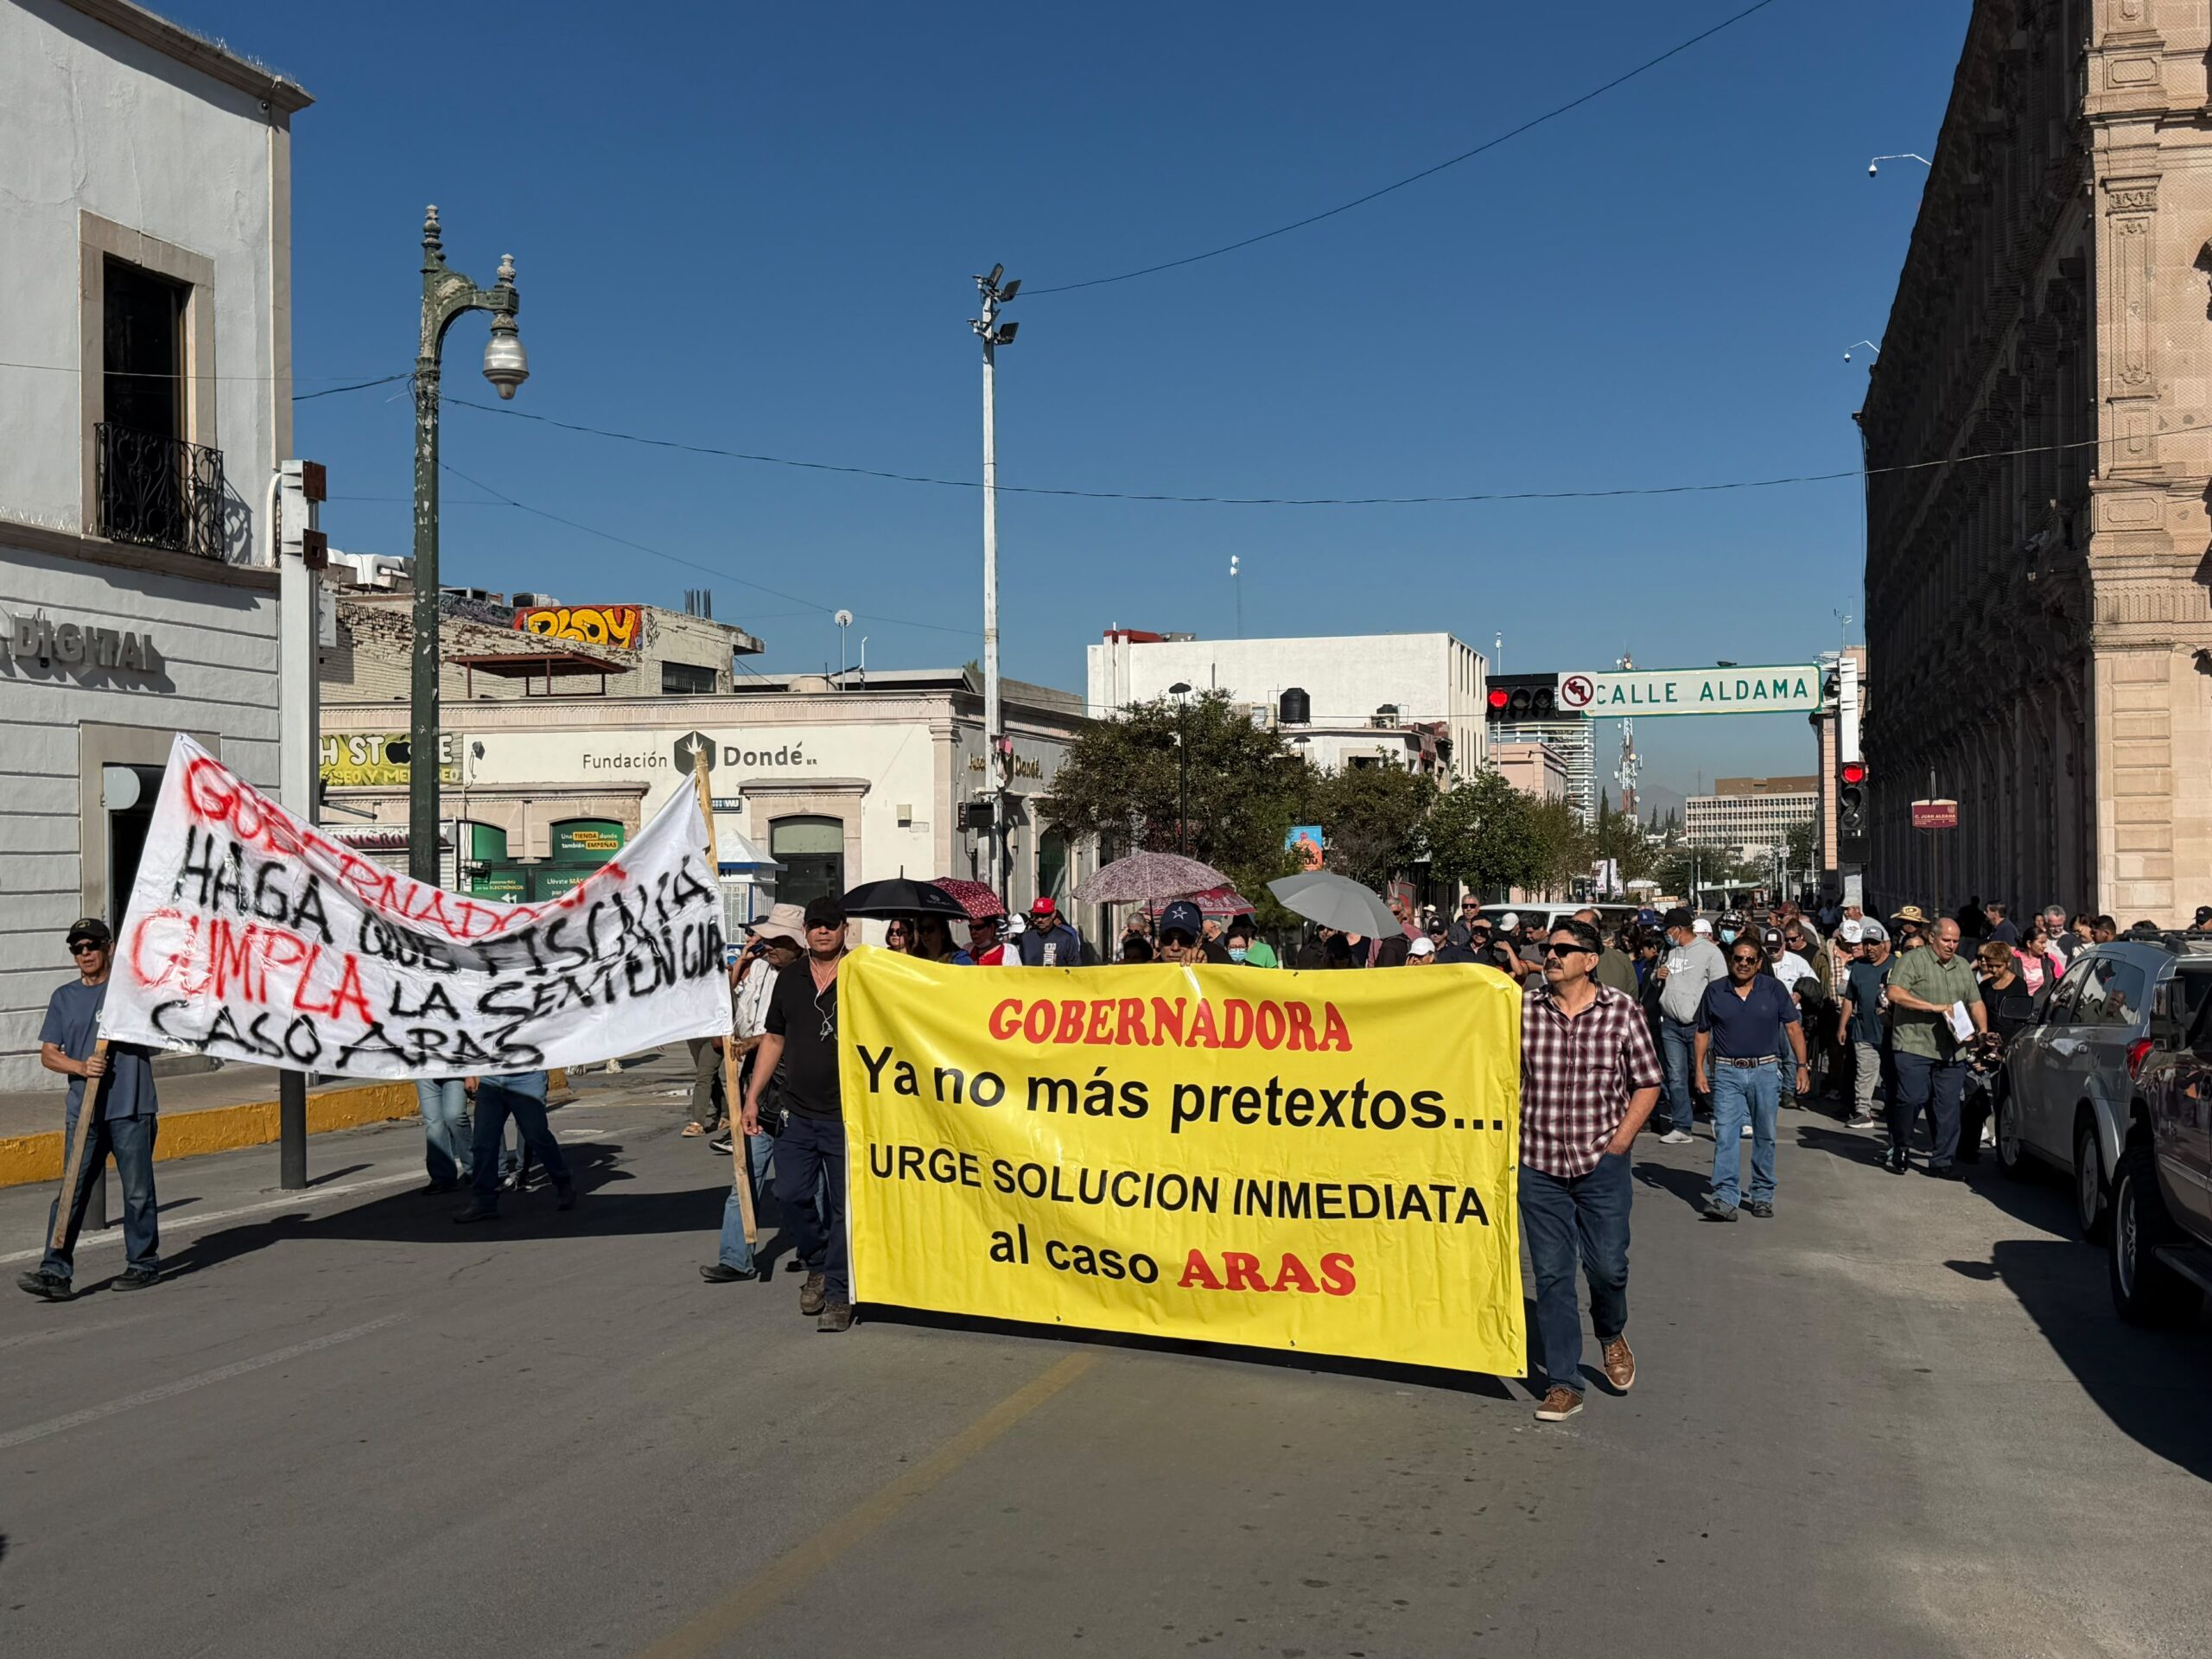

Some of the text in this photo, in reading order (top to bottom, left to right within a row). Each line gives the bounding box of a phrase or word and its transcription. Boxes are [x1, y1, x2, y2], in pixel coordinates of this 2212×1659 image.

[10, 613, 156, 674] DIGITAL
[1596, 677, 1808, 706] CALLE ALDAMA
[582, 741, 804, 769] Fundación Dondé
[174, 824, 334, 944] HAGA
[130, 908, 373, 1025] CUMPLA
[389, 980, 460, 1021] LA
[476, 914, 726, 1025] SENTENCIA
[150, 999, 545, 1070] CASO ARAS
[988, 997, 1354, 1052] GOBERNADORA
[856, 1045, 920, 1096] Ya
[934, 1067, 1005, 1108] no
[1027, 1065, 1148, 1119] más
[870, 1142, 1490, 1226] URGE SOLUCION INMEDIATA
[989, 1223, 1357, 1296] al caso ARAS
